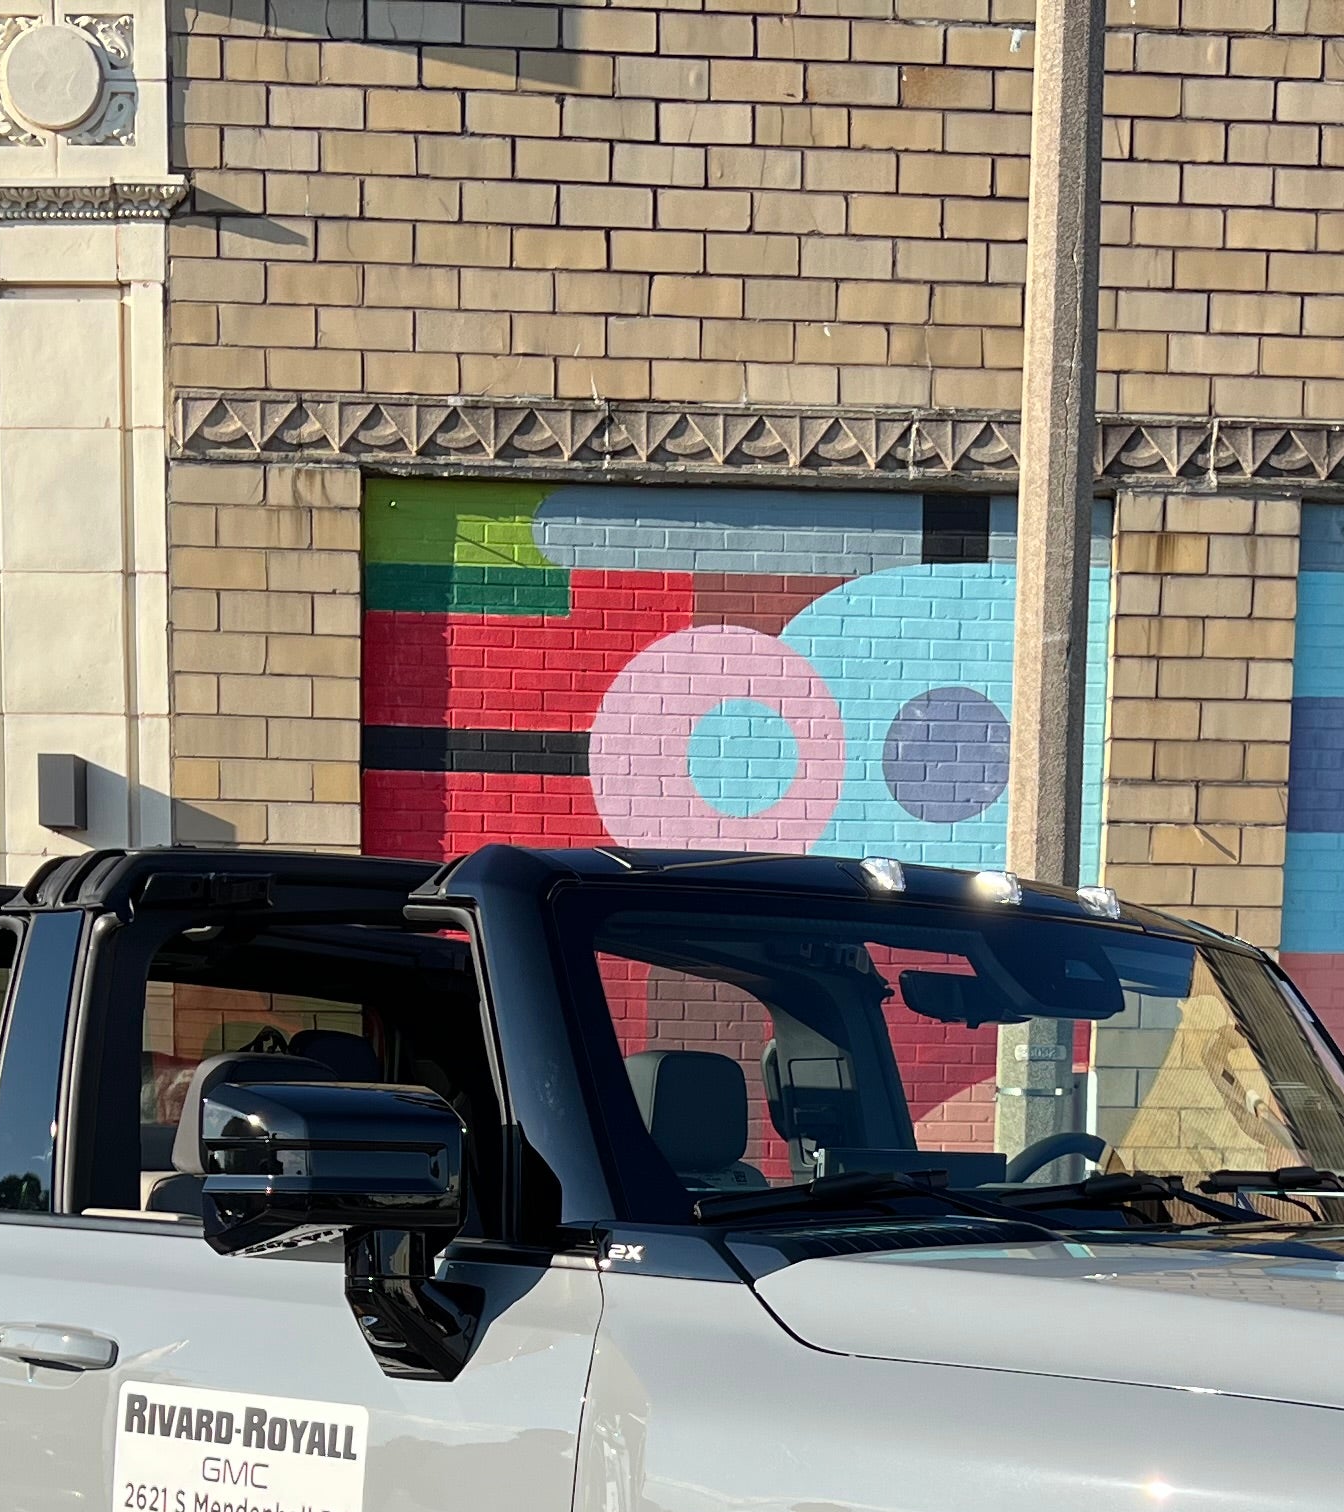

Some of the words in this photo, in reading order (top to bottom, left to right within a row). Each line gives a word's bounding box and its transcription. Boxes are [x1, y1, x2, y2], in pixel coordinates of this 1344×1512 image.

[607, 1243, 644, 1262] 2X
[124, 1393, 357, 1461] RIVARD-ROYALL
[202, 1456, 270, 1489] GMC
